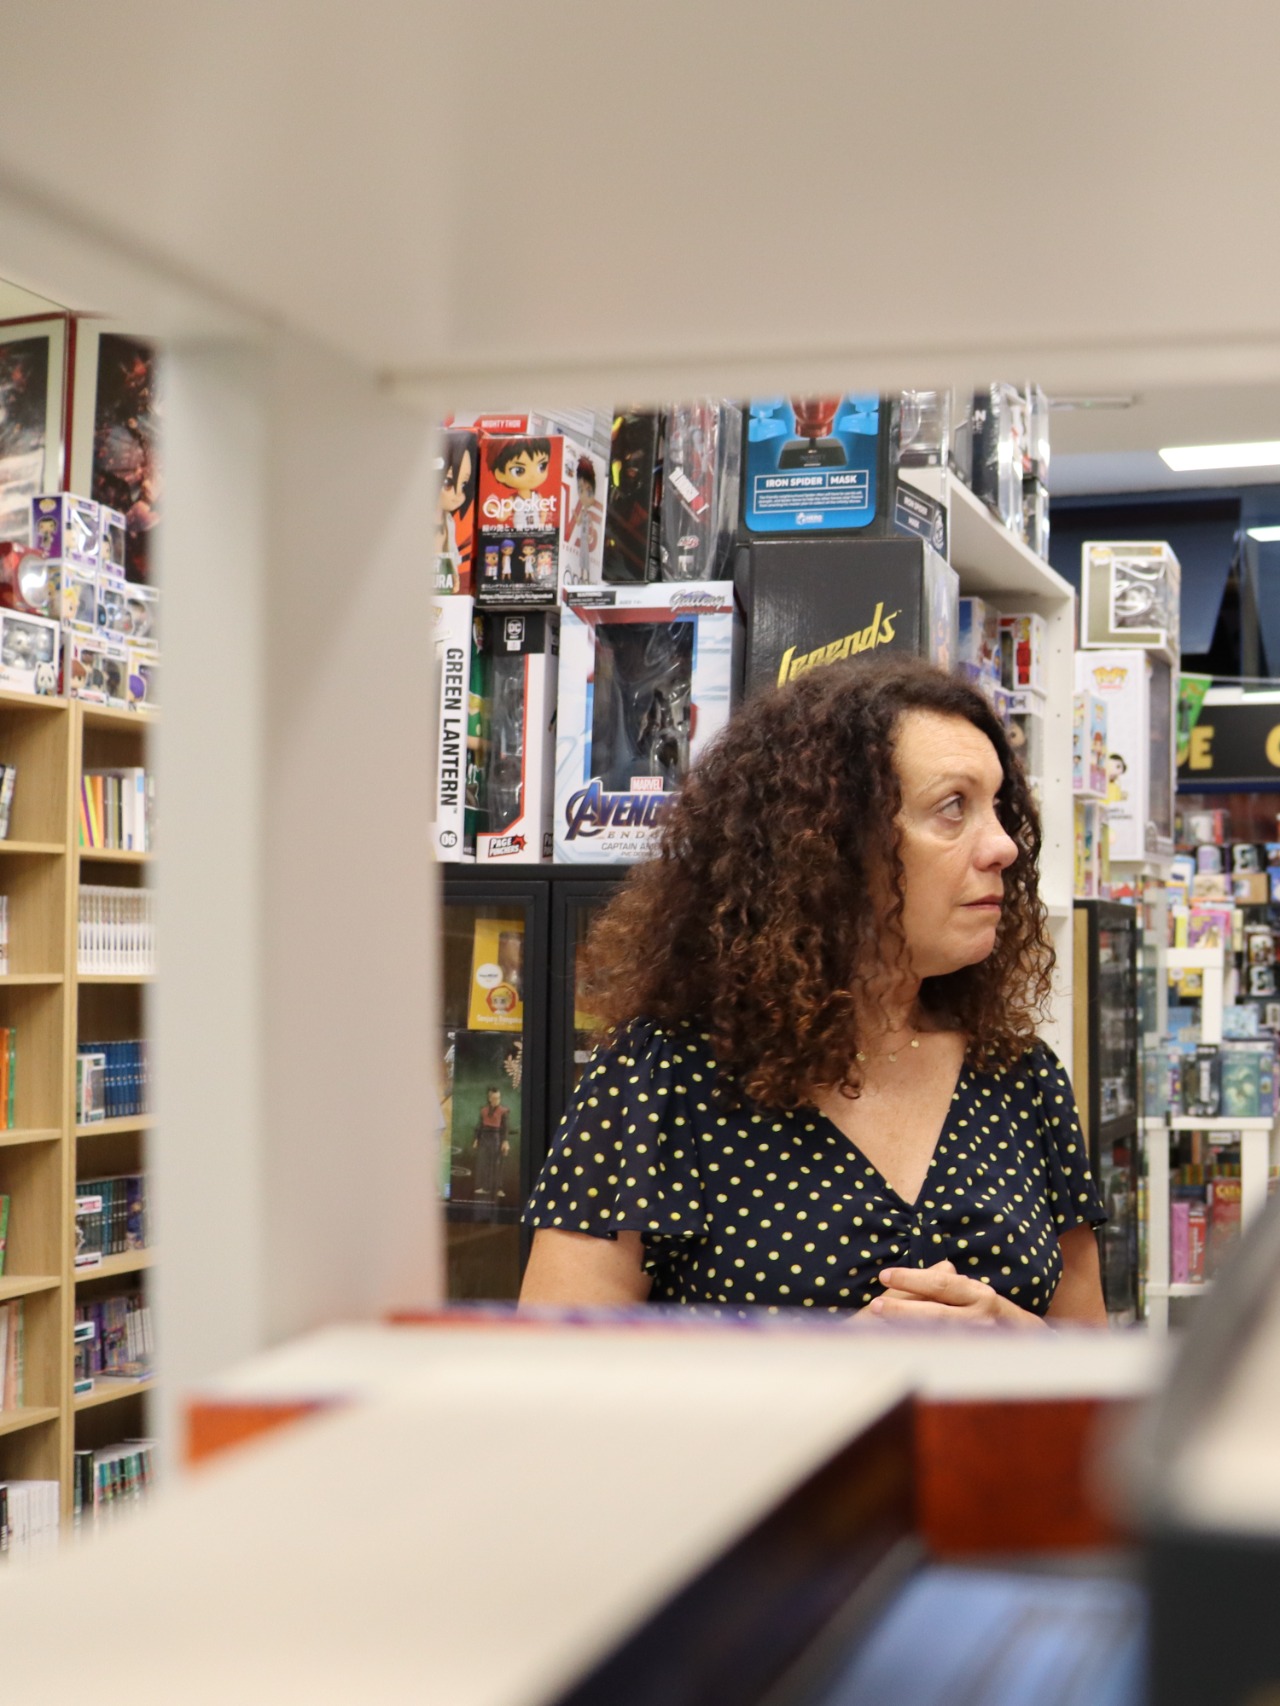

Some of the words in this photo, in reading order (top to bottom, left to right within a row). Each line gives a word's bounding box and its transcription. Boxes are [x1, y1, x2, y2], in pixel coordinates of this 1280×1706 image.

[481, 419, 504, 429] MIGHTY
[505, 419, 522, 429] THOR
[765, 477, 789, 489] IRON
[790, 475, 823, 488] SPIDER
[830, 474, 858, 486] MASK
[507, 621, 522, 635] DC
[444, 648, 464, 710] GREEN
[1177, 726, 1215, 770] E
[440, 718, 461, 806] LANTERN
[633, 778, 662, 791] MARVEL
[565, 780, 682, 841] AVENG
[441, 833, 456, 846] 06
[490, 837, 513, 849] PAGE
[601, 842, 638, 851] CAPTAIN
